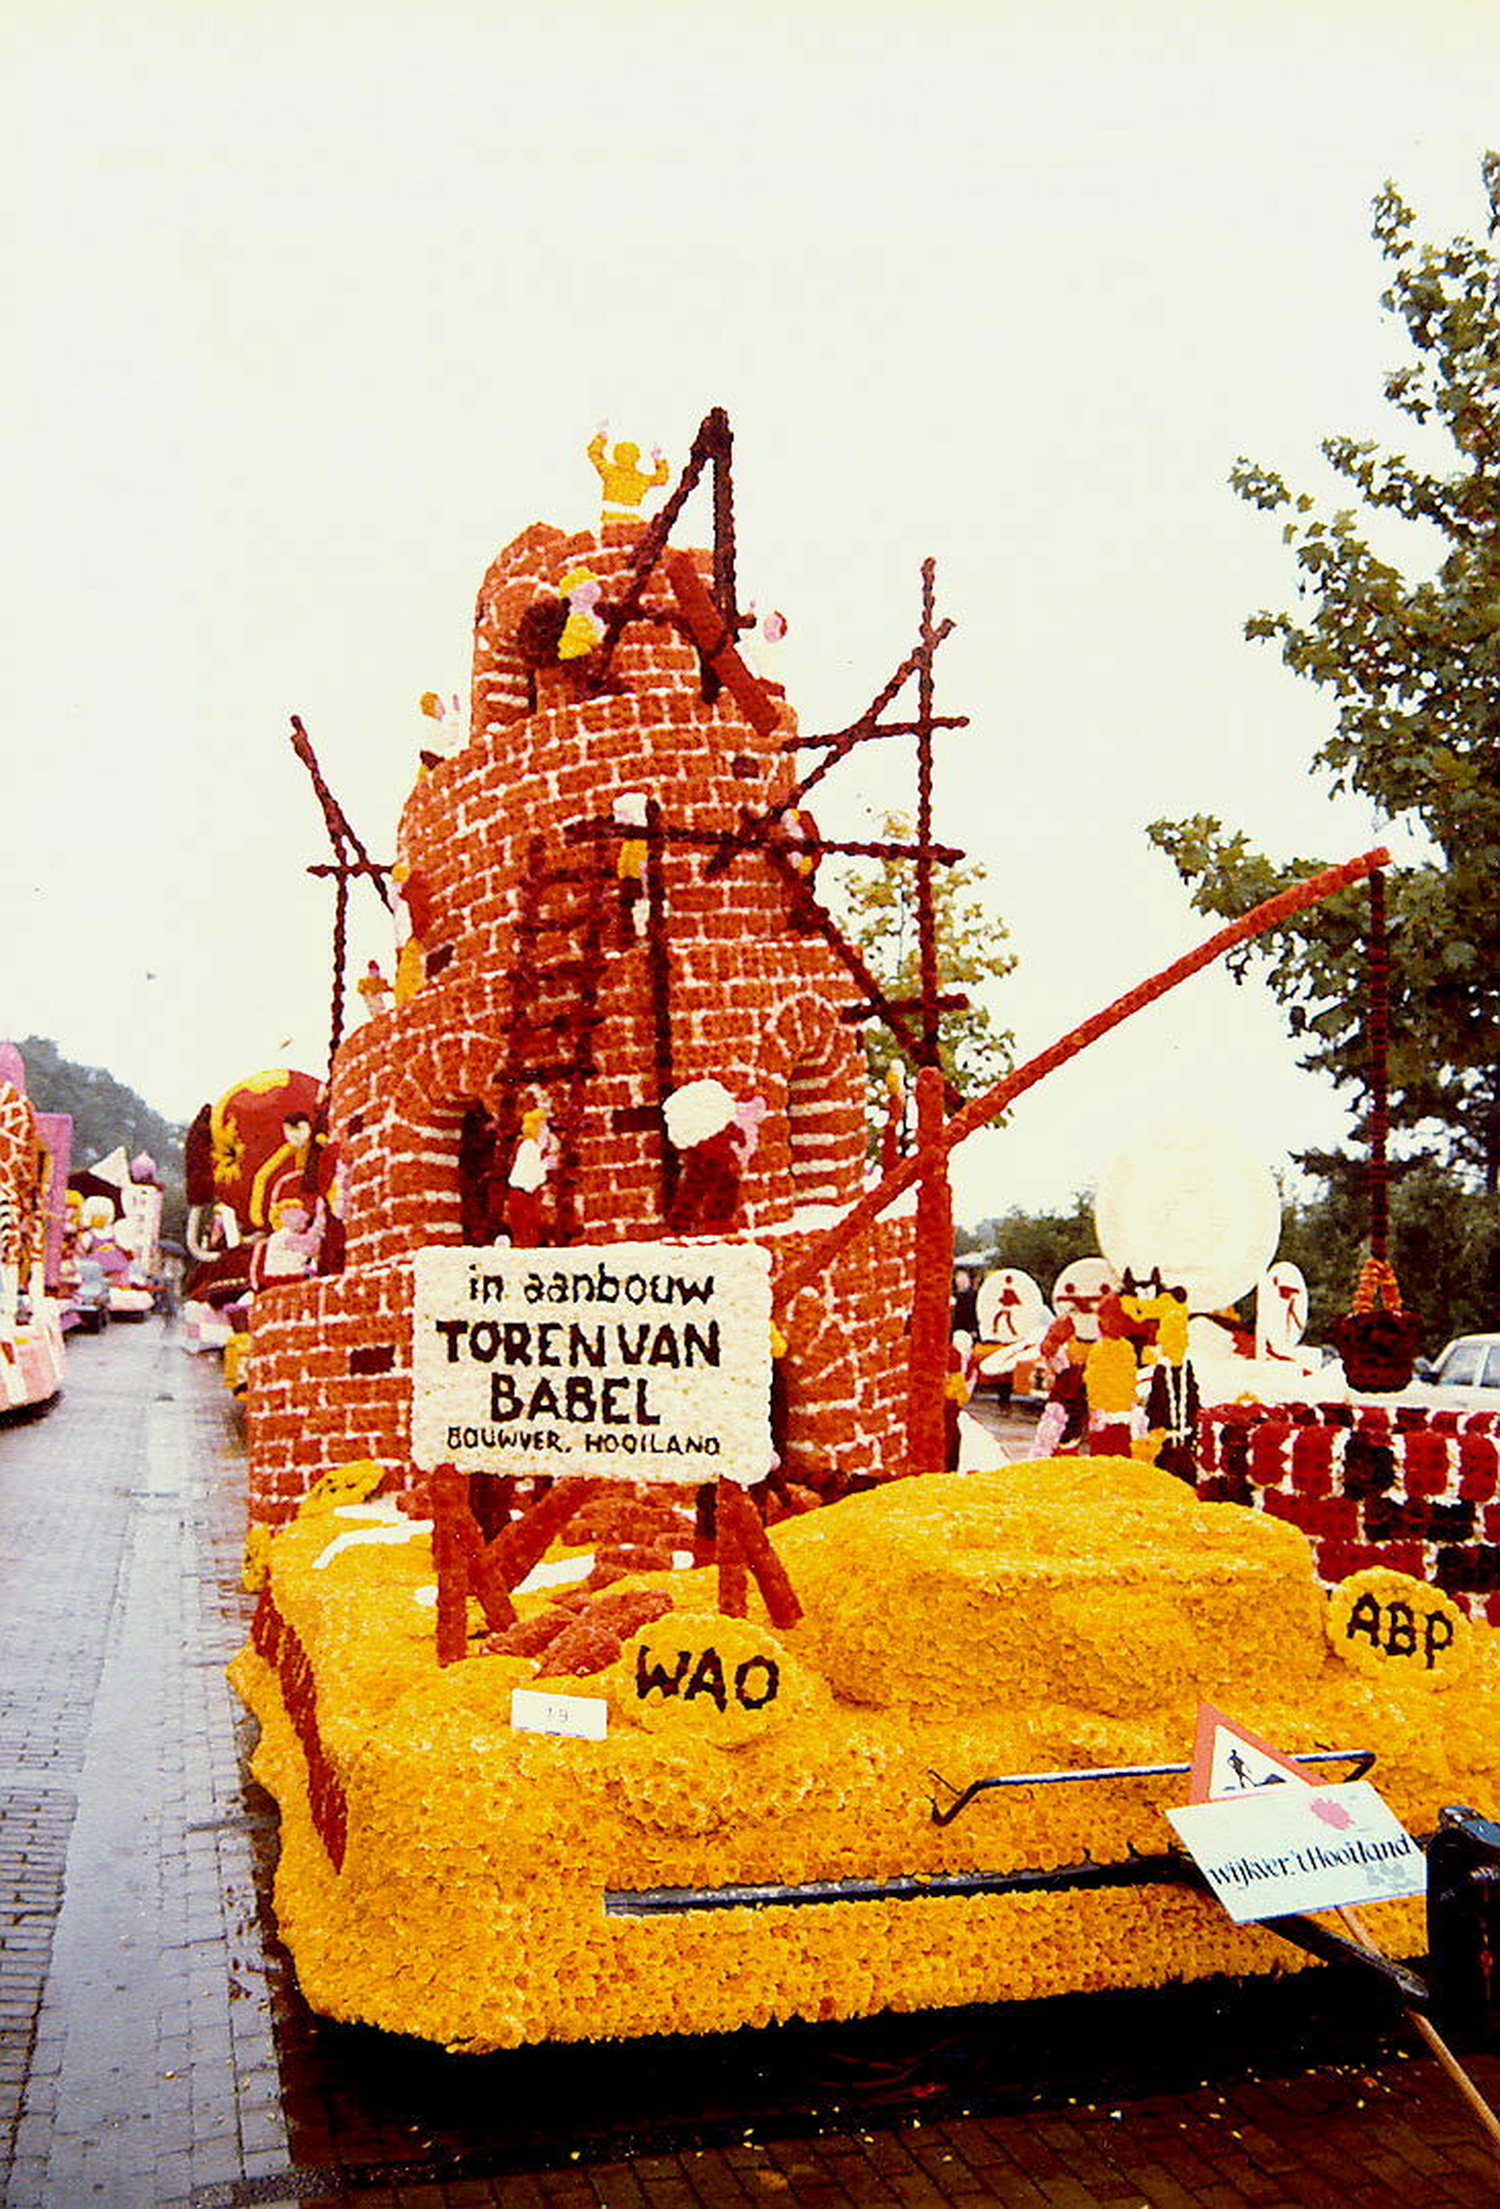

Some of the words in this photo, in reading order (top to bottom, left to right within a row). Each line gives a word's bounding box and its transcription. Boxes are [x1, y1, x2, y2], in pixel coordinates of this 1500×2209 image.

[469, 1264, 504, 1304] in
[523, 1262, 714, 1305] aanbouw
[435, 1320, 608, 1367] TOREN
[617, 1319, 722, 1369] VAN
[490, 1372, 661, 1426] BABEL
[585, 1433, 721, 1456] HOOILAND
[1346, 1592, 1454, 1670] ABP
[634, 1644, 780, 1713] WAO
